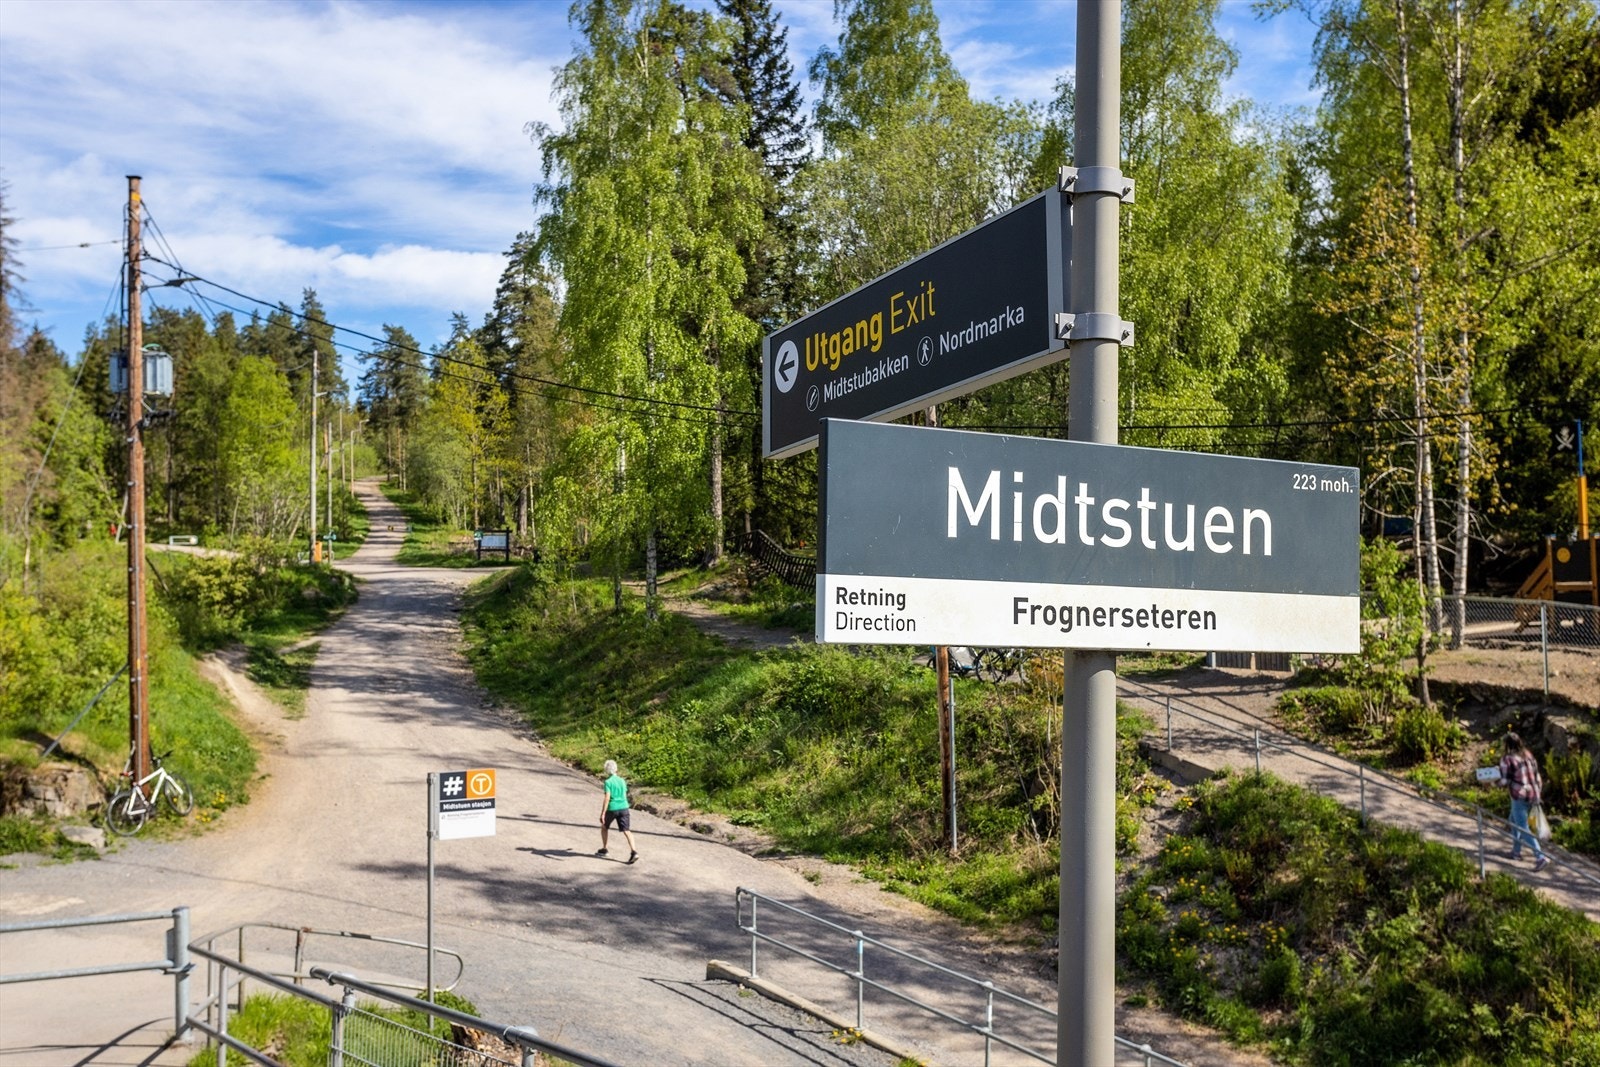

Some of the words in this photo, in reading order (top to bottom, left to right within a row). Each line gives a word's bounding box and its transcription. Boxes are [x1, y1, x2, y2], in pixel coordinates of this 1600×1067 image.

[806, 312, 883, 371] Utgang
[891, 281, 936, 334] Exit
[823, 354, 910, 403] Midtstubakken
[939, 306, 1025, 355] Nordmarka
[1293, 473, 1317, 491] 223
[1320, 476, 1354, 494] moh.
[947, 466, 1273, 557] Midtstuen
[836, 586, 906, 611] Retning
[1013, 597, 1218, 632] Frognerseteren
[836, 611, 917, 633] Direction
